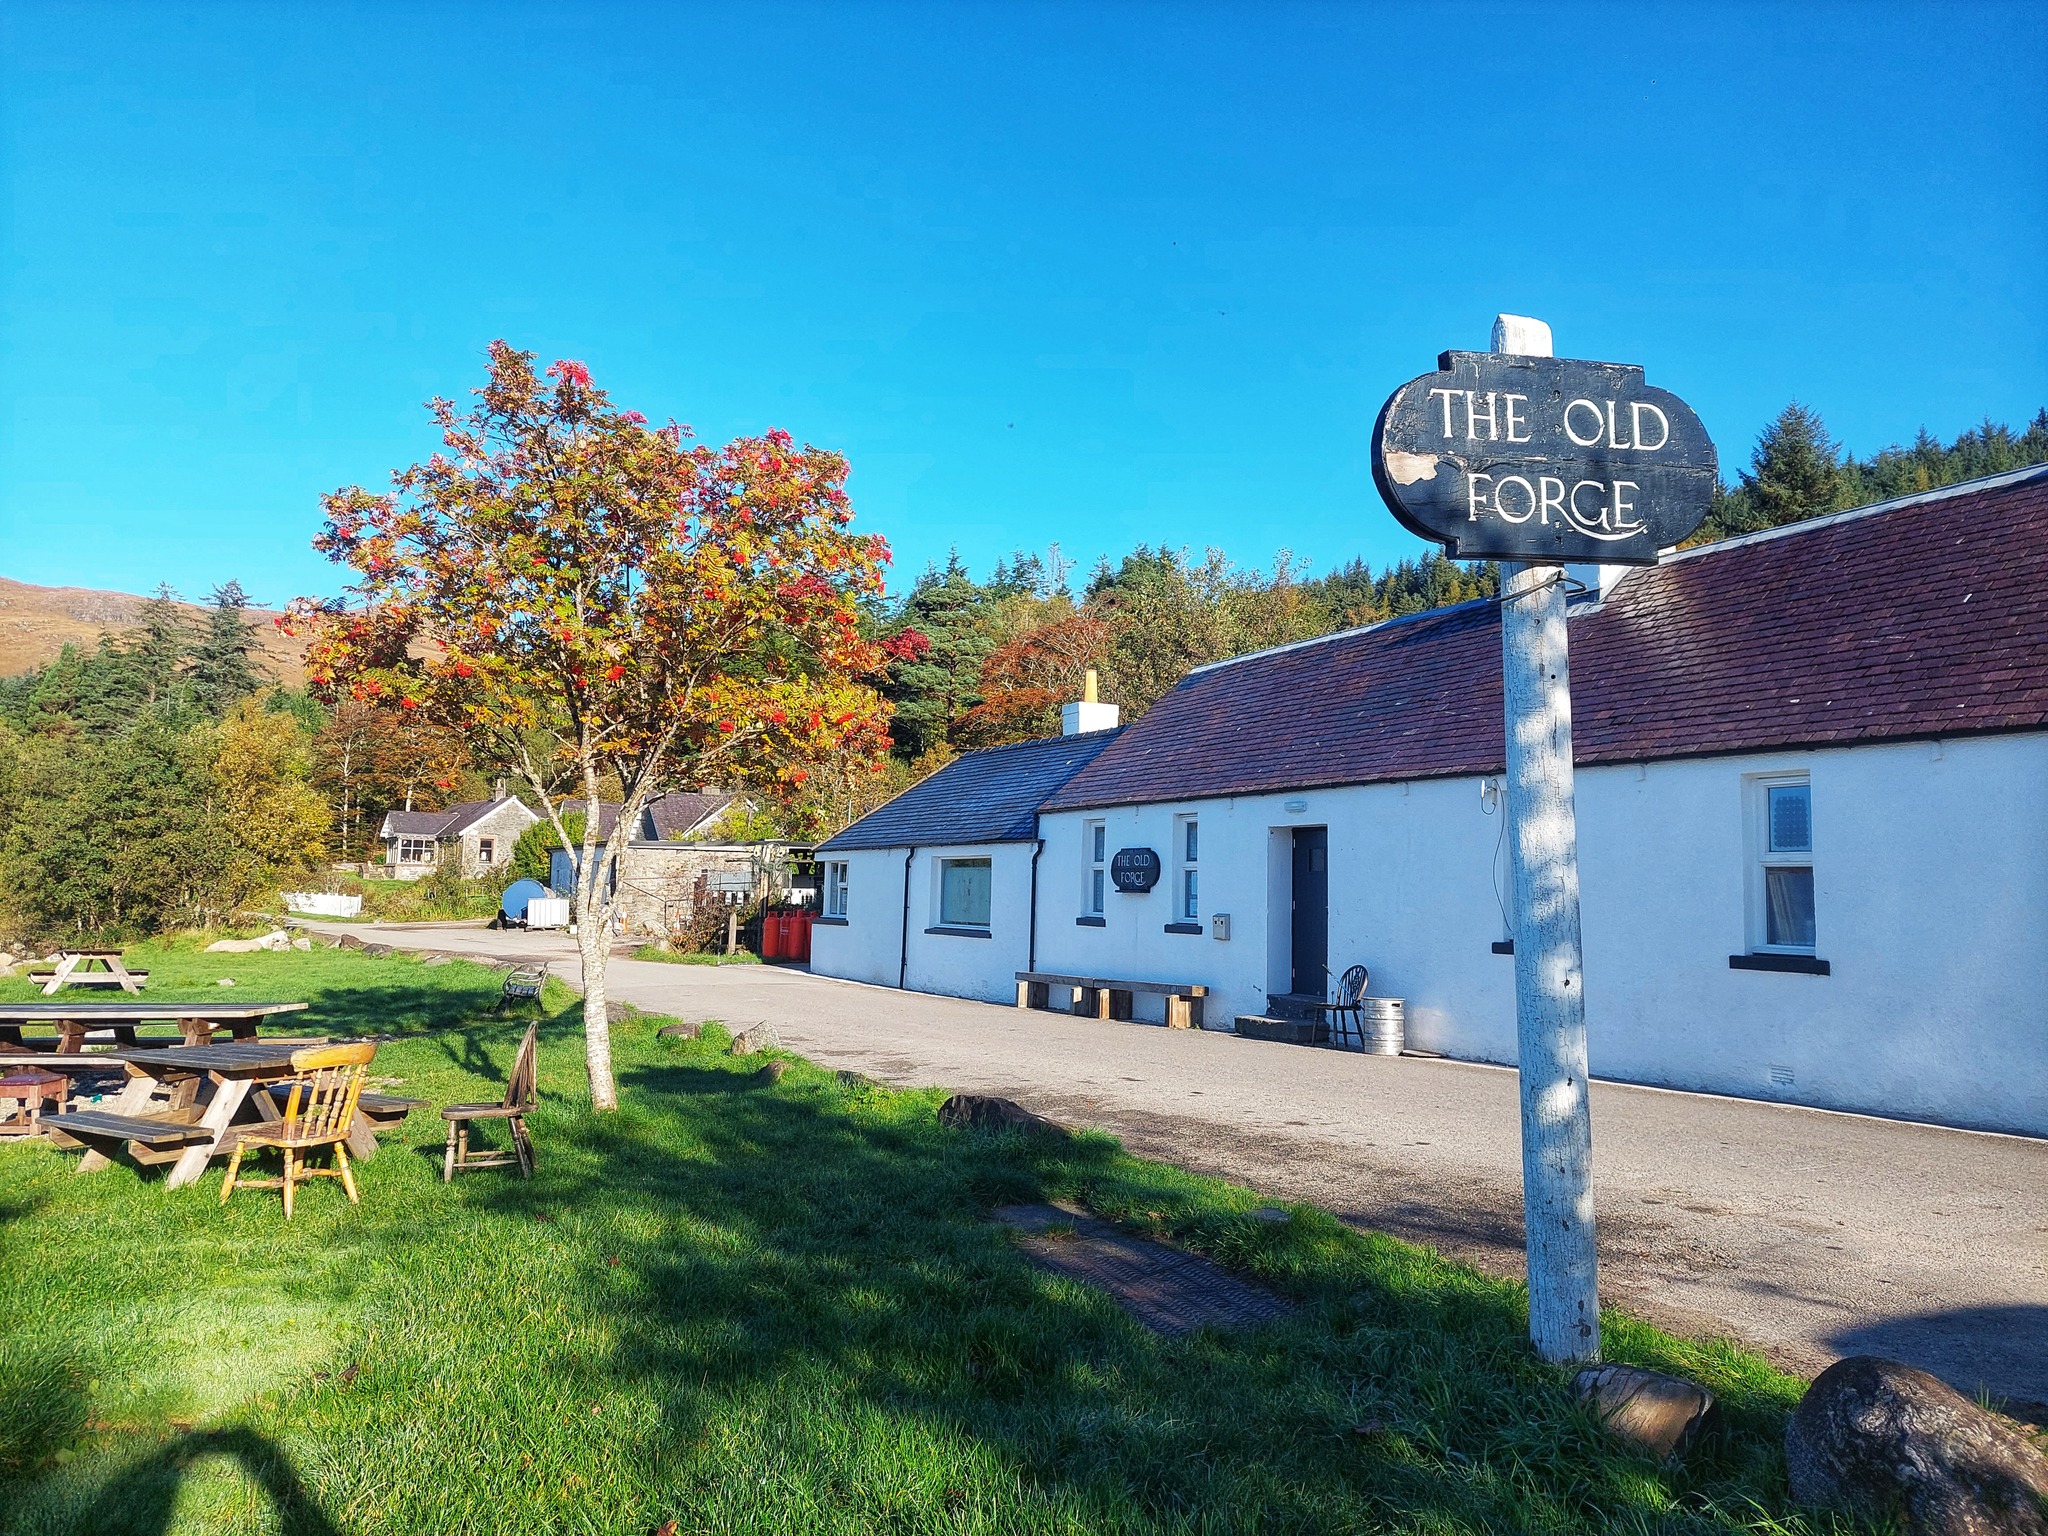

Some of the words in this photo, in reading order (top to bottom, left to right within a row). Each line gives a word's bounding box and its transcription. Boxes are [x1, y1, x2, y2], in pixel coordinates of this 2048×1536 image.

[1427, 388, 1532, 443] THE
[1563, 398, 1669, 451] OLD
[1466, 472, 1649, 541] FORGE
[1117, 855, 1130, 867] THE
[1133, 854, 1150, 867] OLD
[1120, 871, 1147, 886] FORGE
